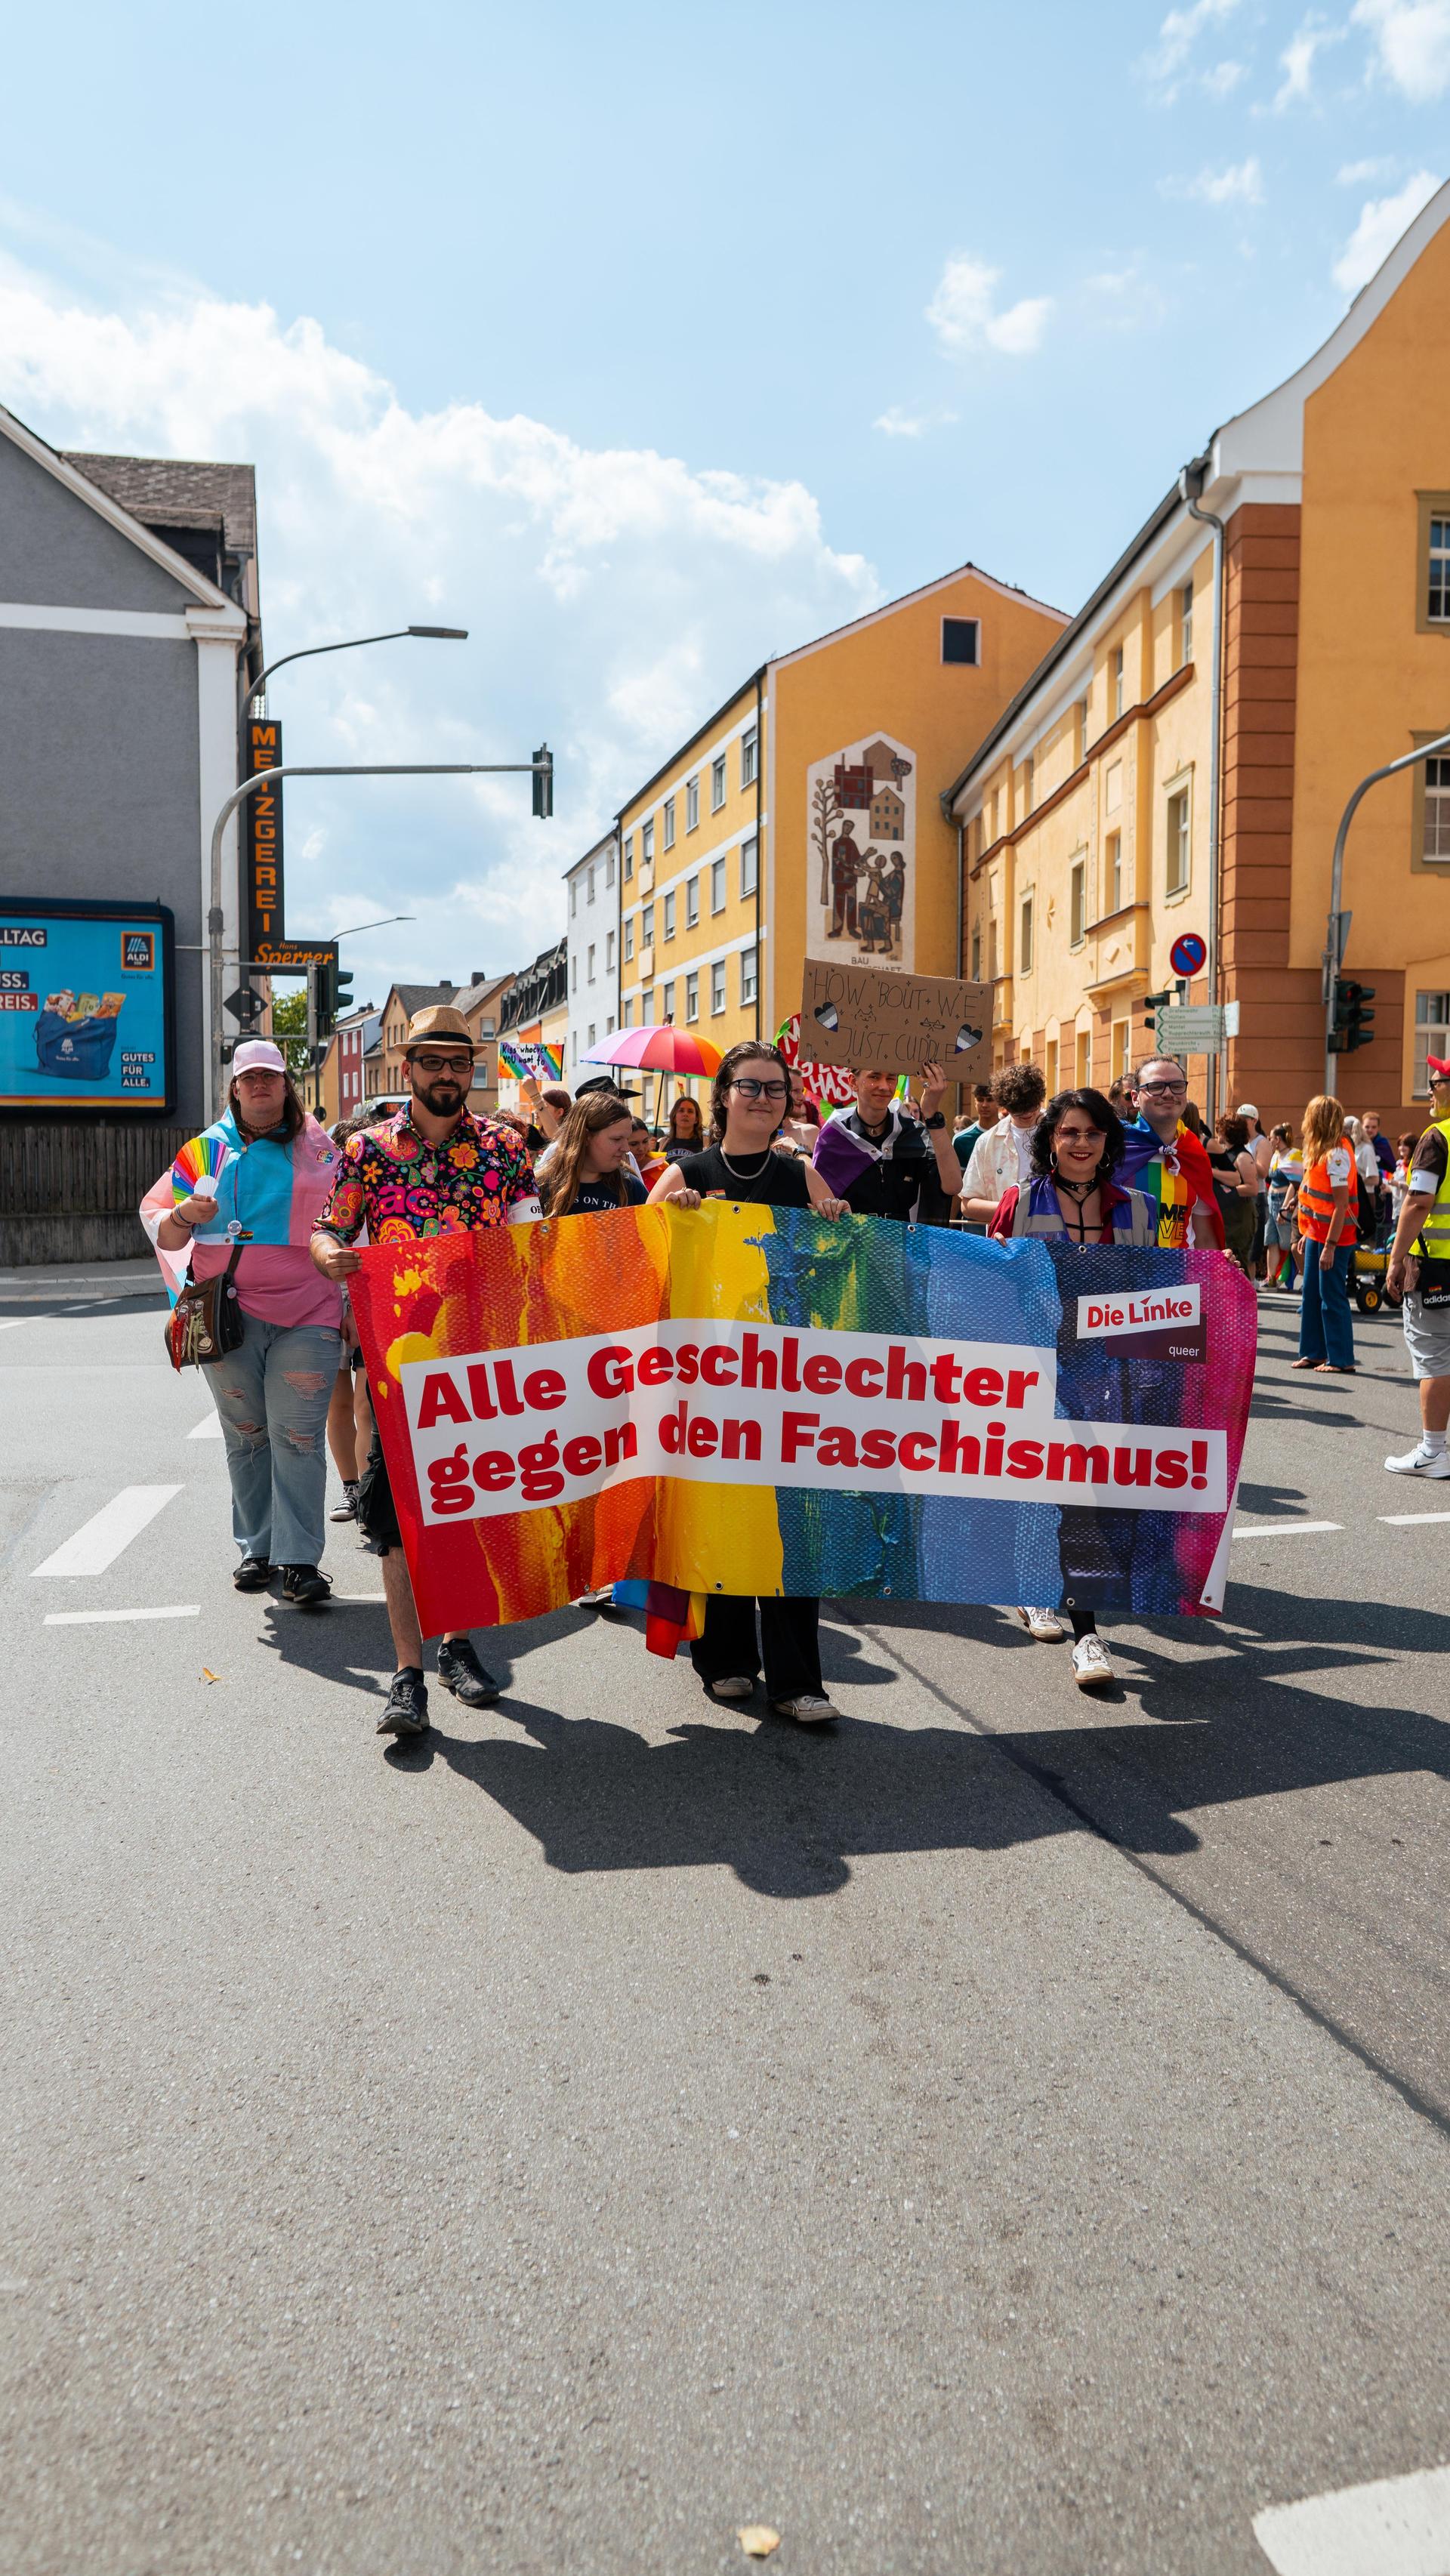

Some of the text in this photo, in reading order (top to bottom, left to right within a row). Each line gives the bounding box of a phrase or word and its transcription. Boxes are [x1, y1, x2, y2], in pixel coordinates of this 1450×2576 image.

[0, 973, 26, 988] SS.
[813, 967, 978, 1018] HOW 'BOUT WE
[502, 1044, 548, 1054] Kiss whoever
[838, 1026, 890, 1060] JUST
[895, 1033, 958, 1063] CUDDLE
[122, 1054, 154, 1062] GUTES
[503, 1055, 545, 1066] YOU want to
[122, 1064, 142, 1075] FÜR
[122, 1078, 149, 1087] ALLE.
[583, 1196, 599, 1206] ON
[603, 1200, 617, 1210] TH
[1088, 1295, 1192, 1328] Die Linke
[1169, 1345, 1199, 1357] queer
[417, 1332, 1040, 1429] Alle Geschlechter
[427, 1399, 1208, 1515] gegen den Faschismus!
